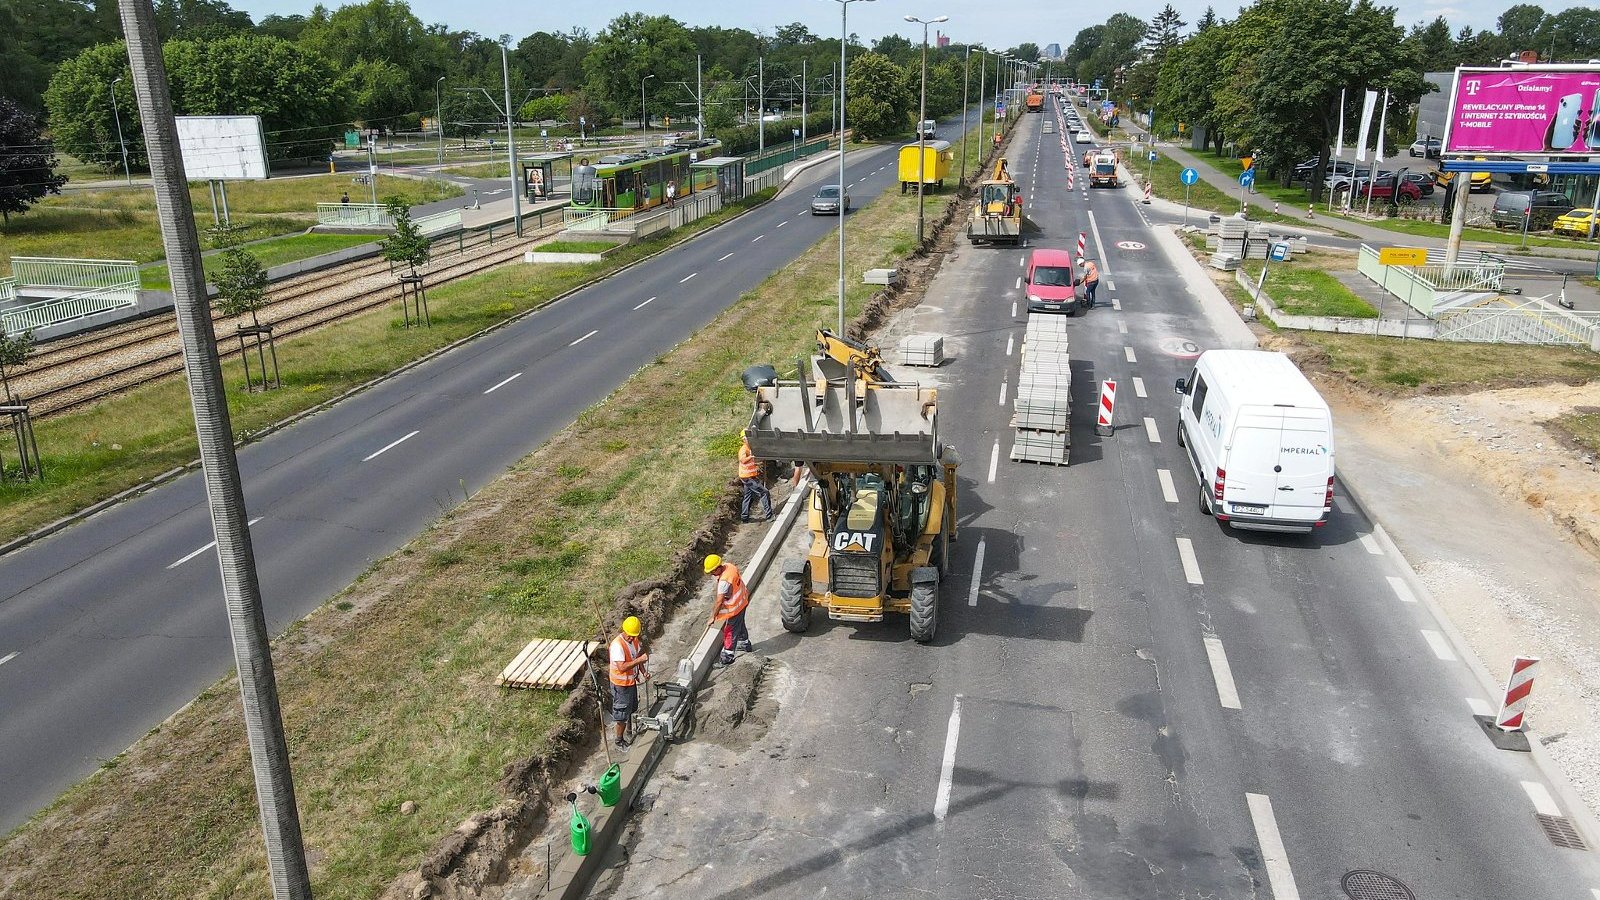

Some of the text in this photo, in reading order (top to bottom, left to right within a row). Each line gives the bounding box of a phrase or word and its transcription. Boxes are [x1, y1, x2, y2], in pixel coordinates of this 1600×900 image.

[1466, 80, 1481, 95] T
[1517, 85, 1553, 93] Działamy!
[1504, 112, 1547, 120] SZYBKOŚCIĄ
[1280, 447, 1320, 455] IMPERIAL
[834, 531, 877, 552] CAT
